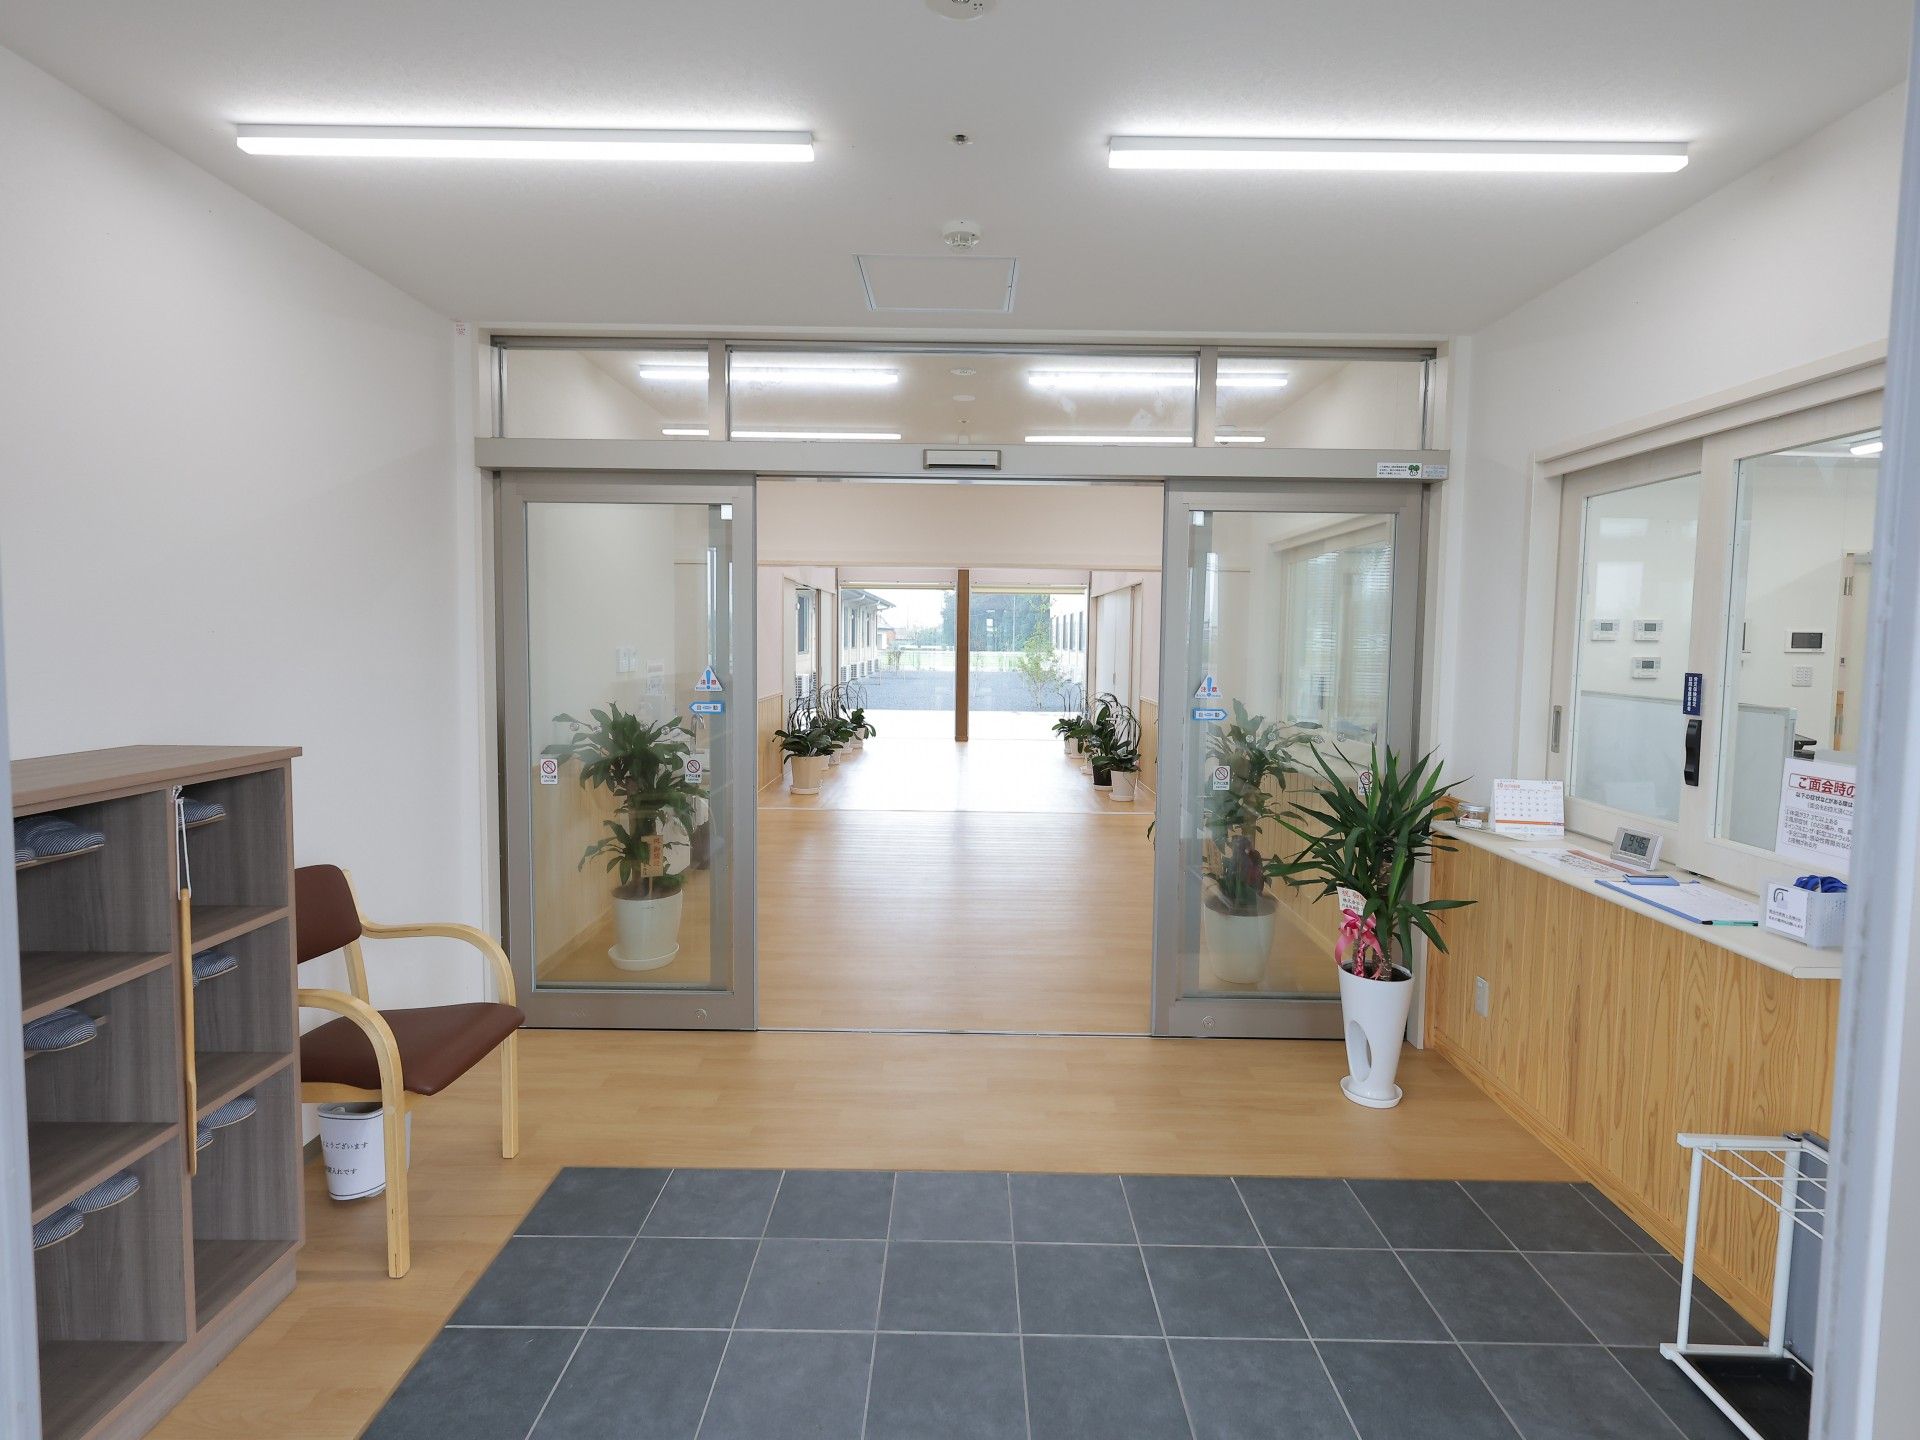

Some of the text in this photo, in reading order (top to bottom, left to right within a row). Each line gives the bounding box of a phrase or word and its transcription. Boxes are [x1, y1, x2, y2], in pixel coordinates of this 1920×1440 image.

[1798, 776, 1856, 798] ご面会時の
